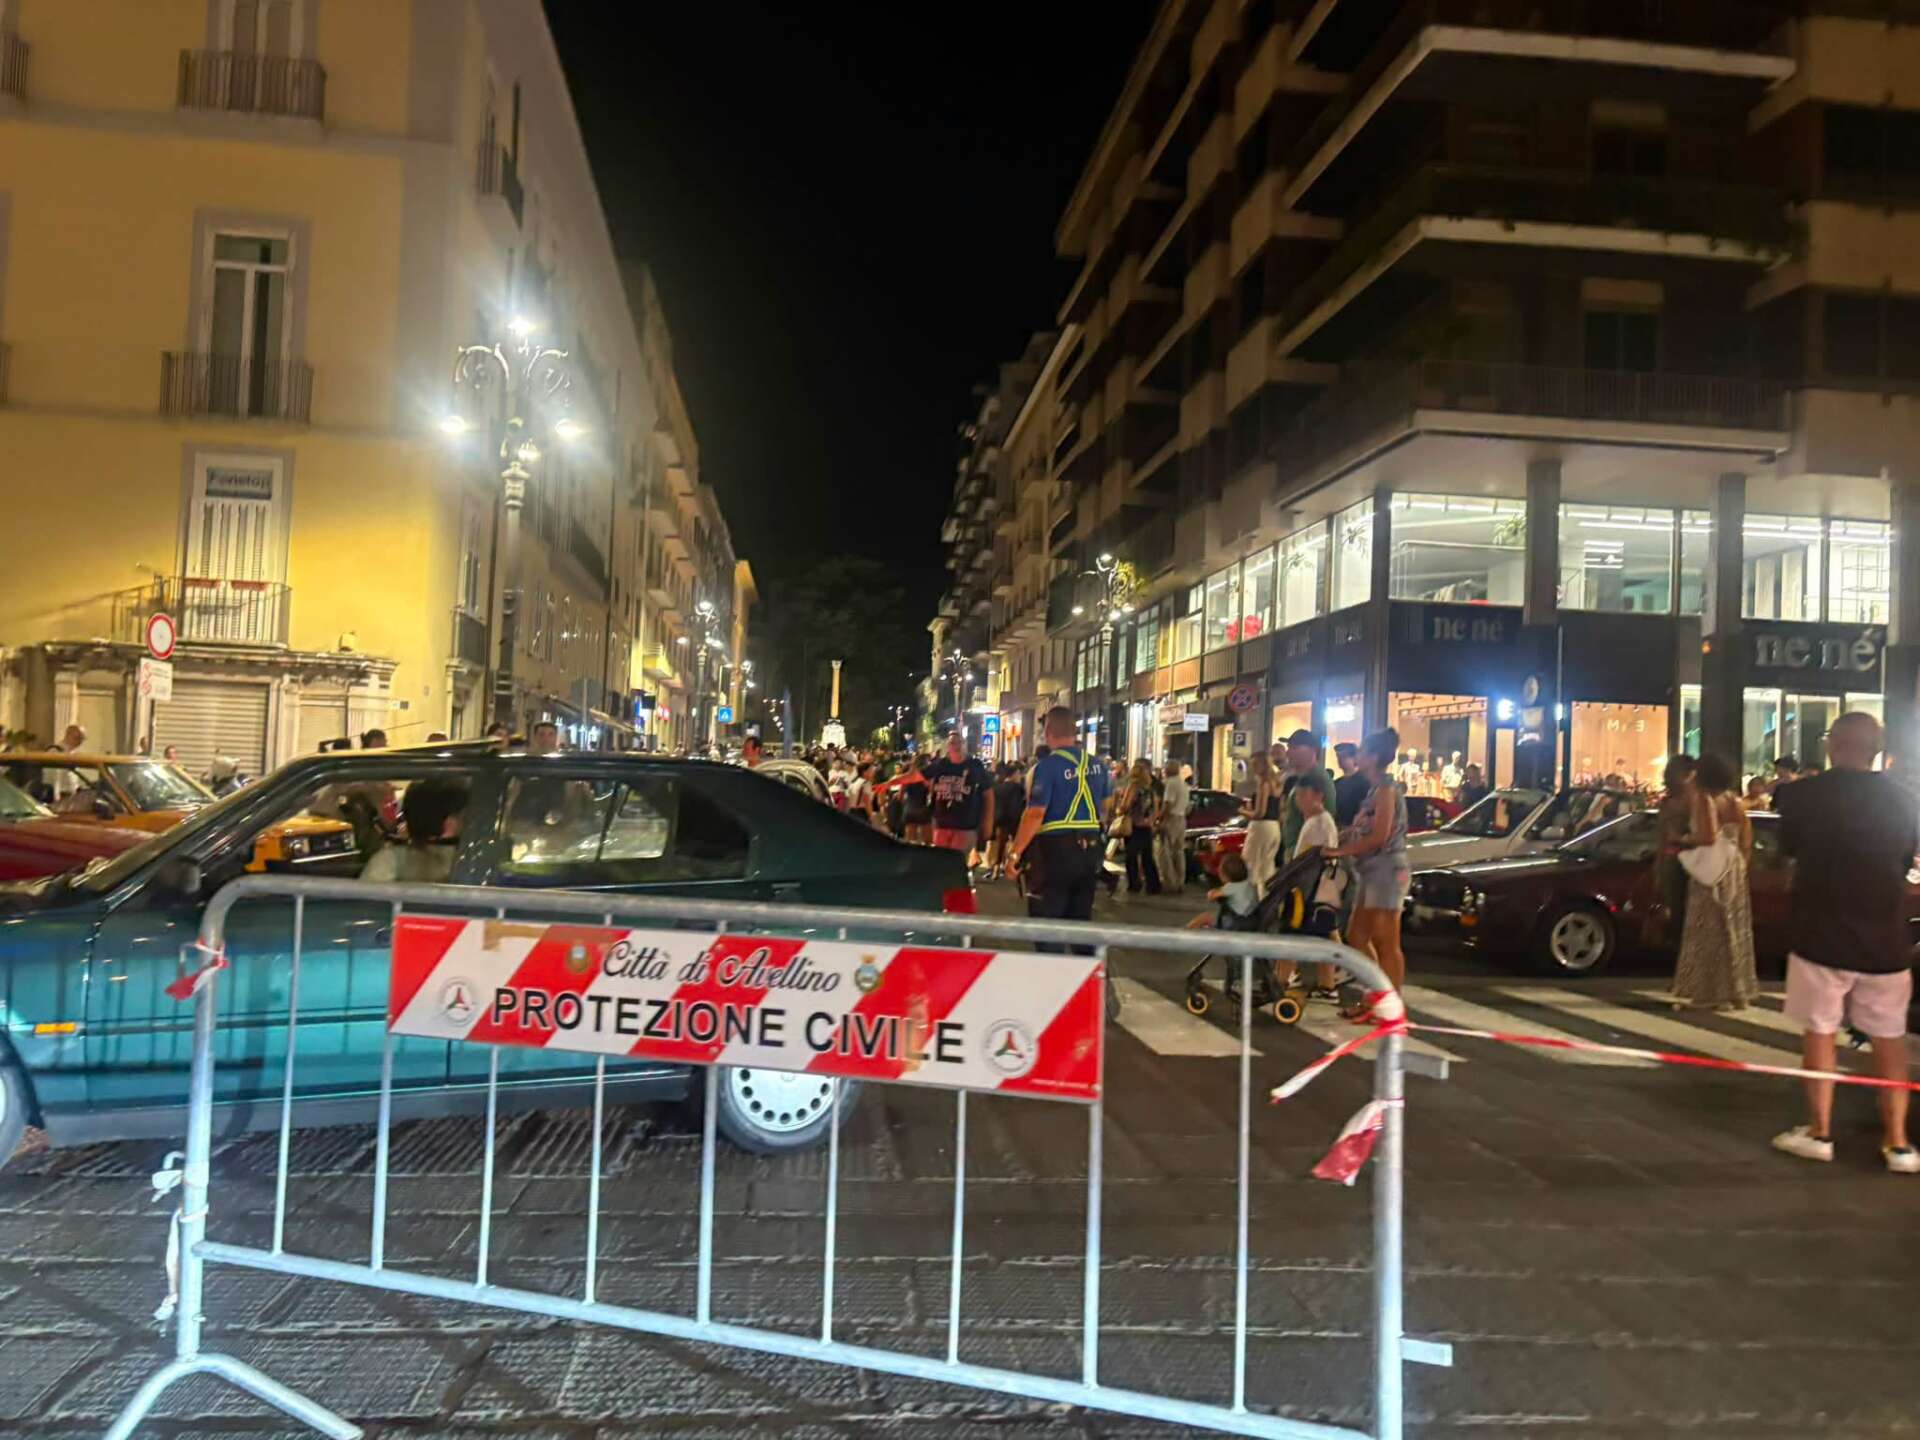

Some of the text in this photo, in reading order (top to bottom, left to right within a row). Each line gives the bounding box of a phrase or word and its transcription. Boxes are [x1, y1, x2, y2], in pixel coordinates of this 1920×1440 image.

[603, 940, 841, 992] Città di Avellino
[493, 987, 785, 1047] PROTEZIONE
[805, 1011, 965, 1064] CIVILE
